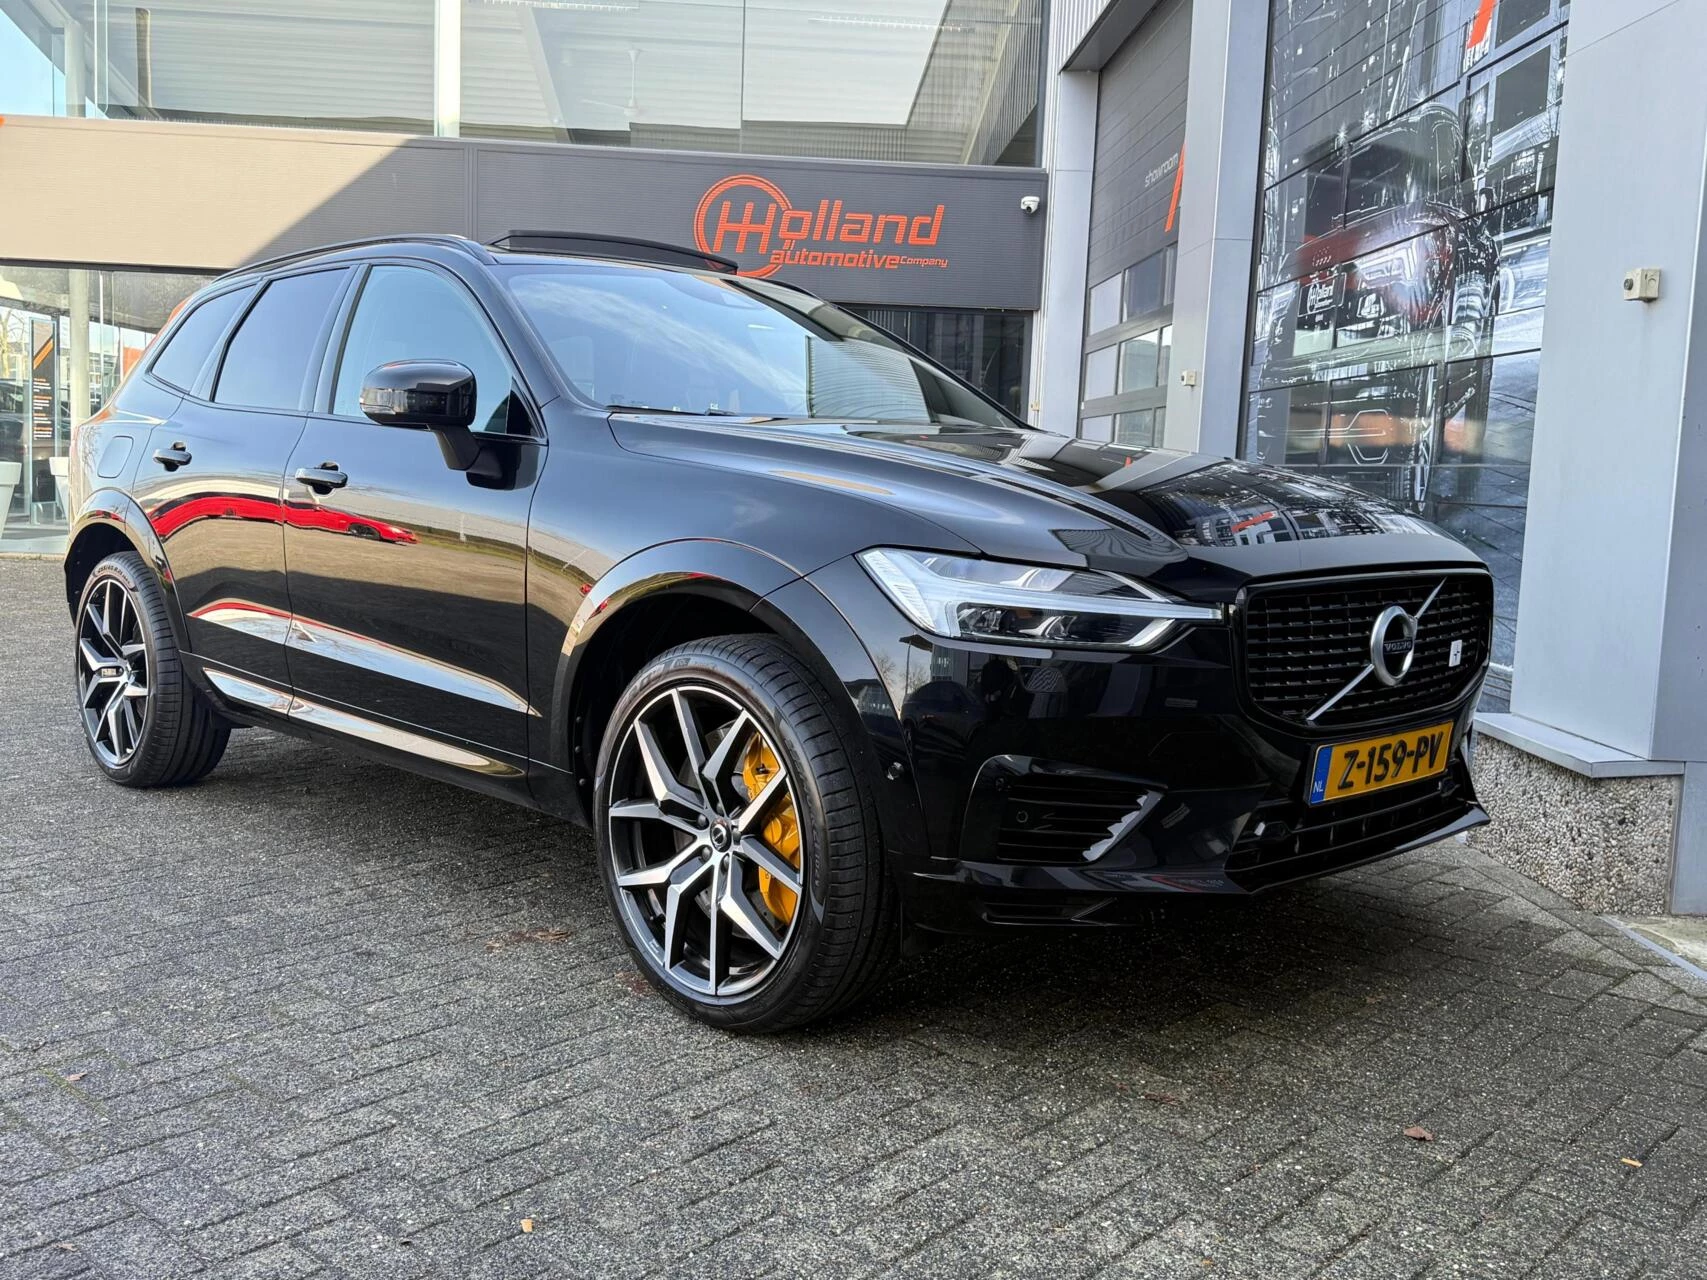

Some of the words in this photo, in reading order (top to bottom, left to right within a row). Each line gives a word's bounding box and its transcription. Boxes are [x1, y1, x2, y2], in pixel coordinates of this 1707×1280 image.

[1145, 153, 1178, 188] showroom
[770, 248, 899, 269] automotive
[899, 255, 948, 268] Company
[1384, 641, 1412, 651] VOLVO
[1312, 781, 1324, 794] NL
[1337, 731, 1444, 791] Z-159-PV
